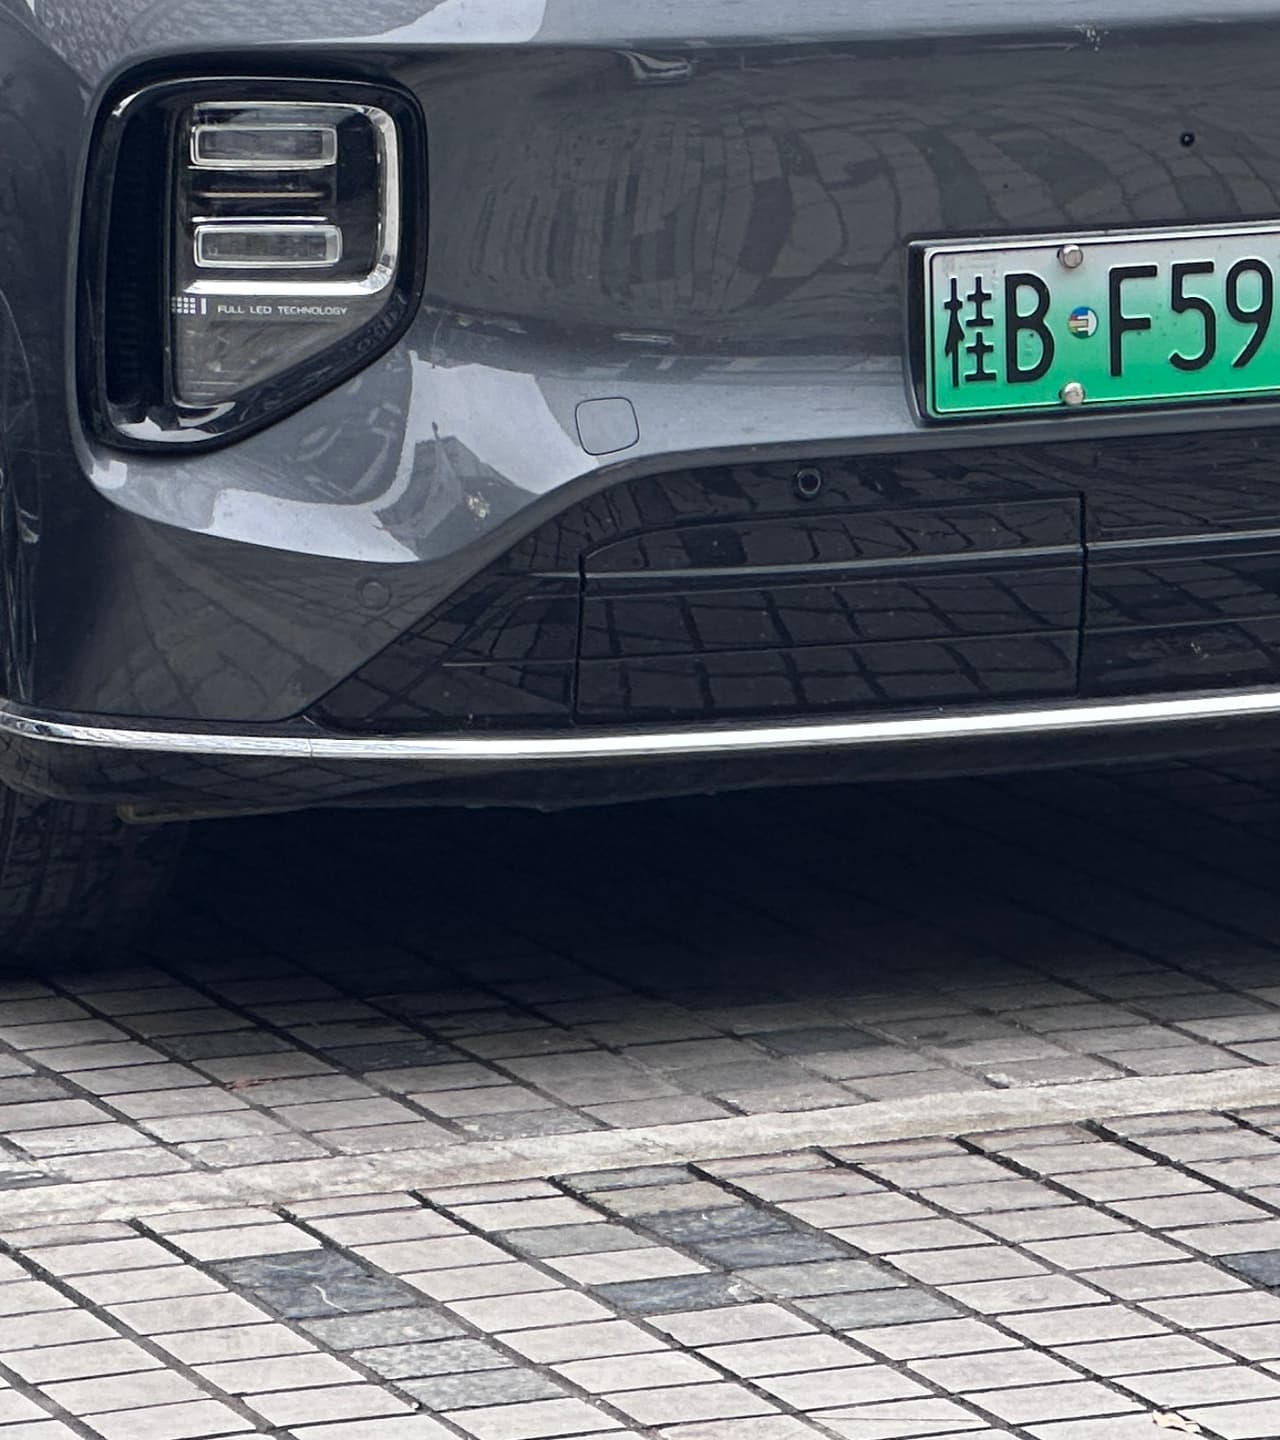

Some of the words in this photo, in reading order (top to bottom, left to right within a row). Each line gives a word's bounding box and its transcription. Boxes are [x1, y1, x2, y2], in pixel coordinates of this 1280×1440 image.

[217, 304, 245, 315] FULL
[249, 304, 273, 315] LED
[277, 305, 349, 316] TECHNOLOGY
